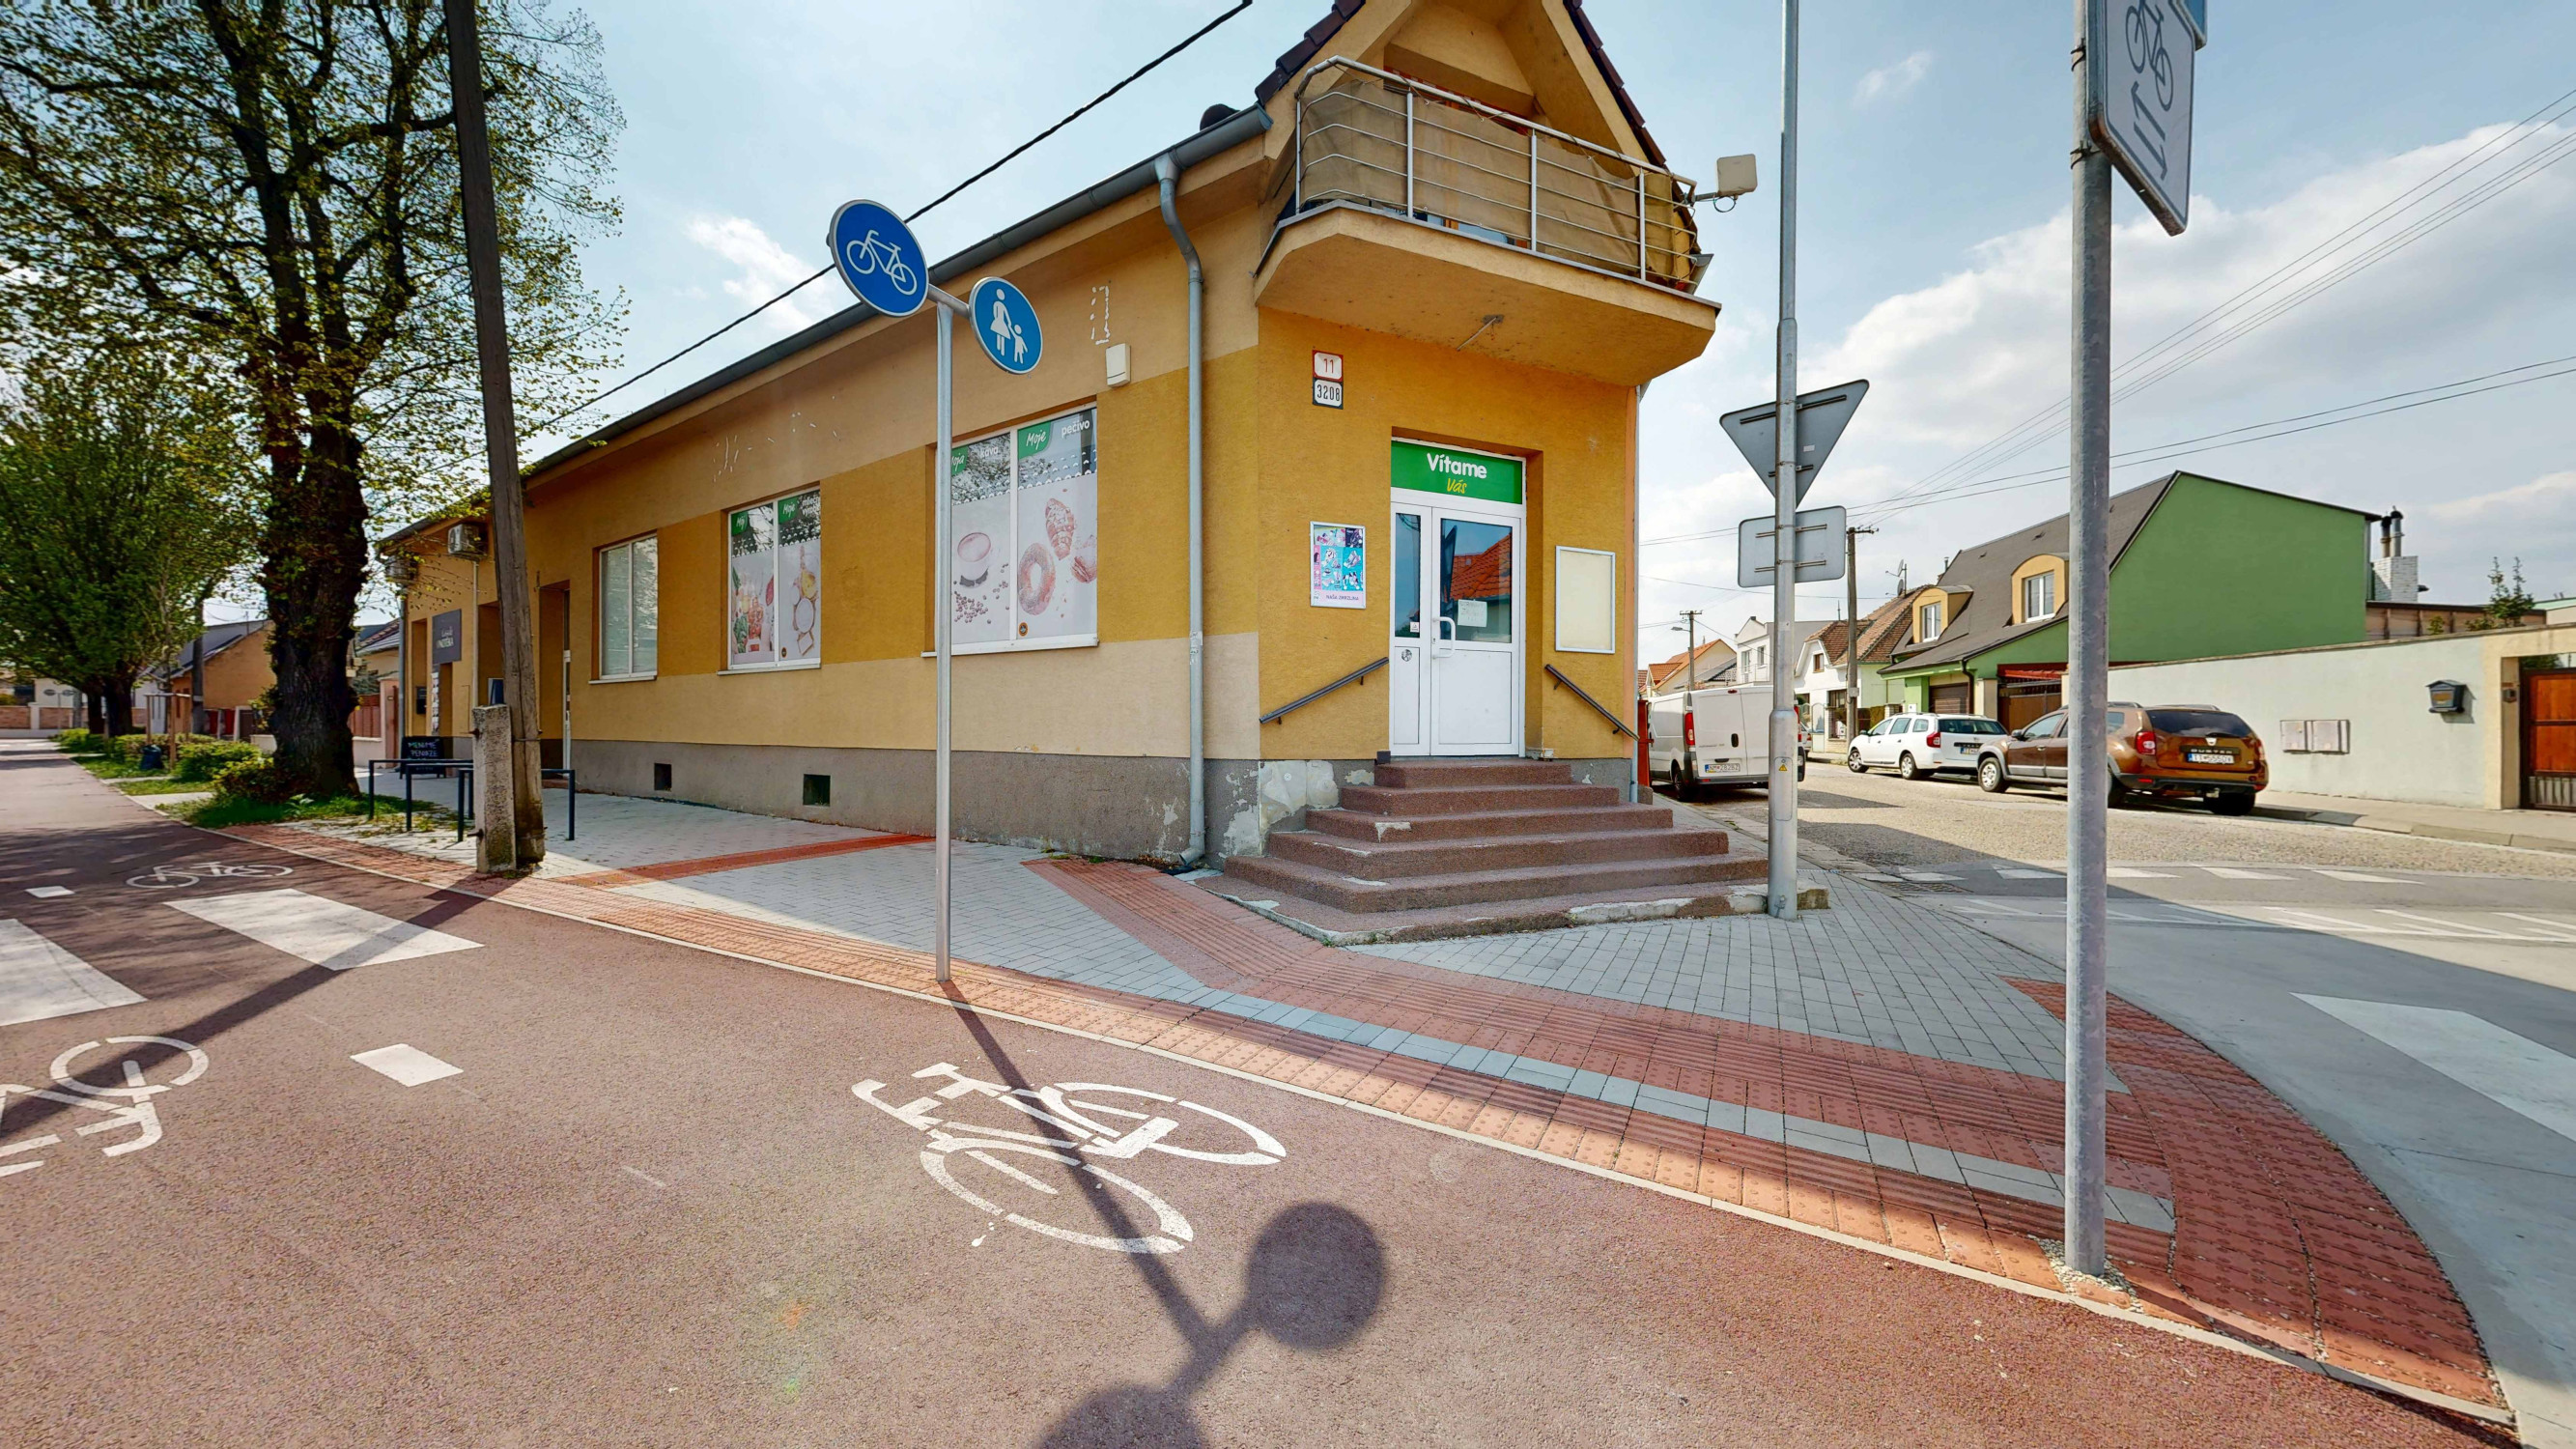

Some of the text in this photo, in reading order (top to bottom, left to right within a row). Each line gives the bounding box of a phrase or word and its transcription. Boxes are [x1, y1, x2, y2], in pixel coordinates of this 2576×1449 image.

[1323, 357, 1334, 374] 11
[1316, 384, 1341, 402] 3208
[1026, 429, 1047, 451] Moje
[1427, 452, 1487, 479] Vítame
[1446, 477, 1467, 495] Vás
